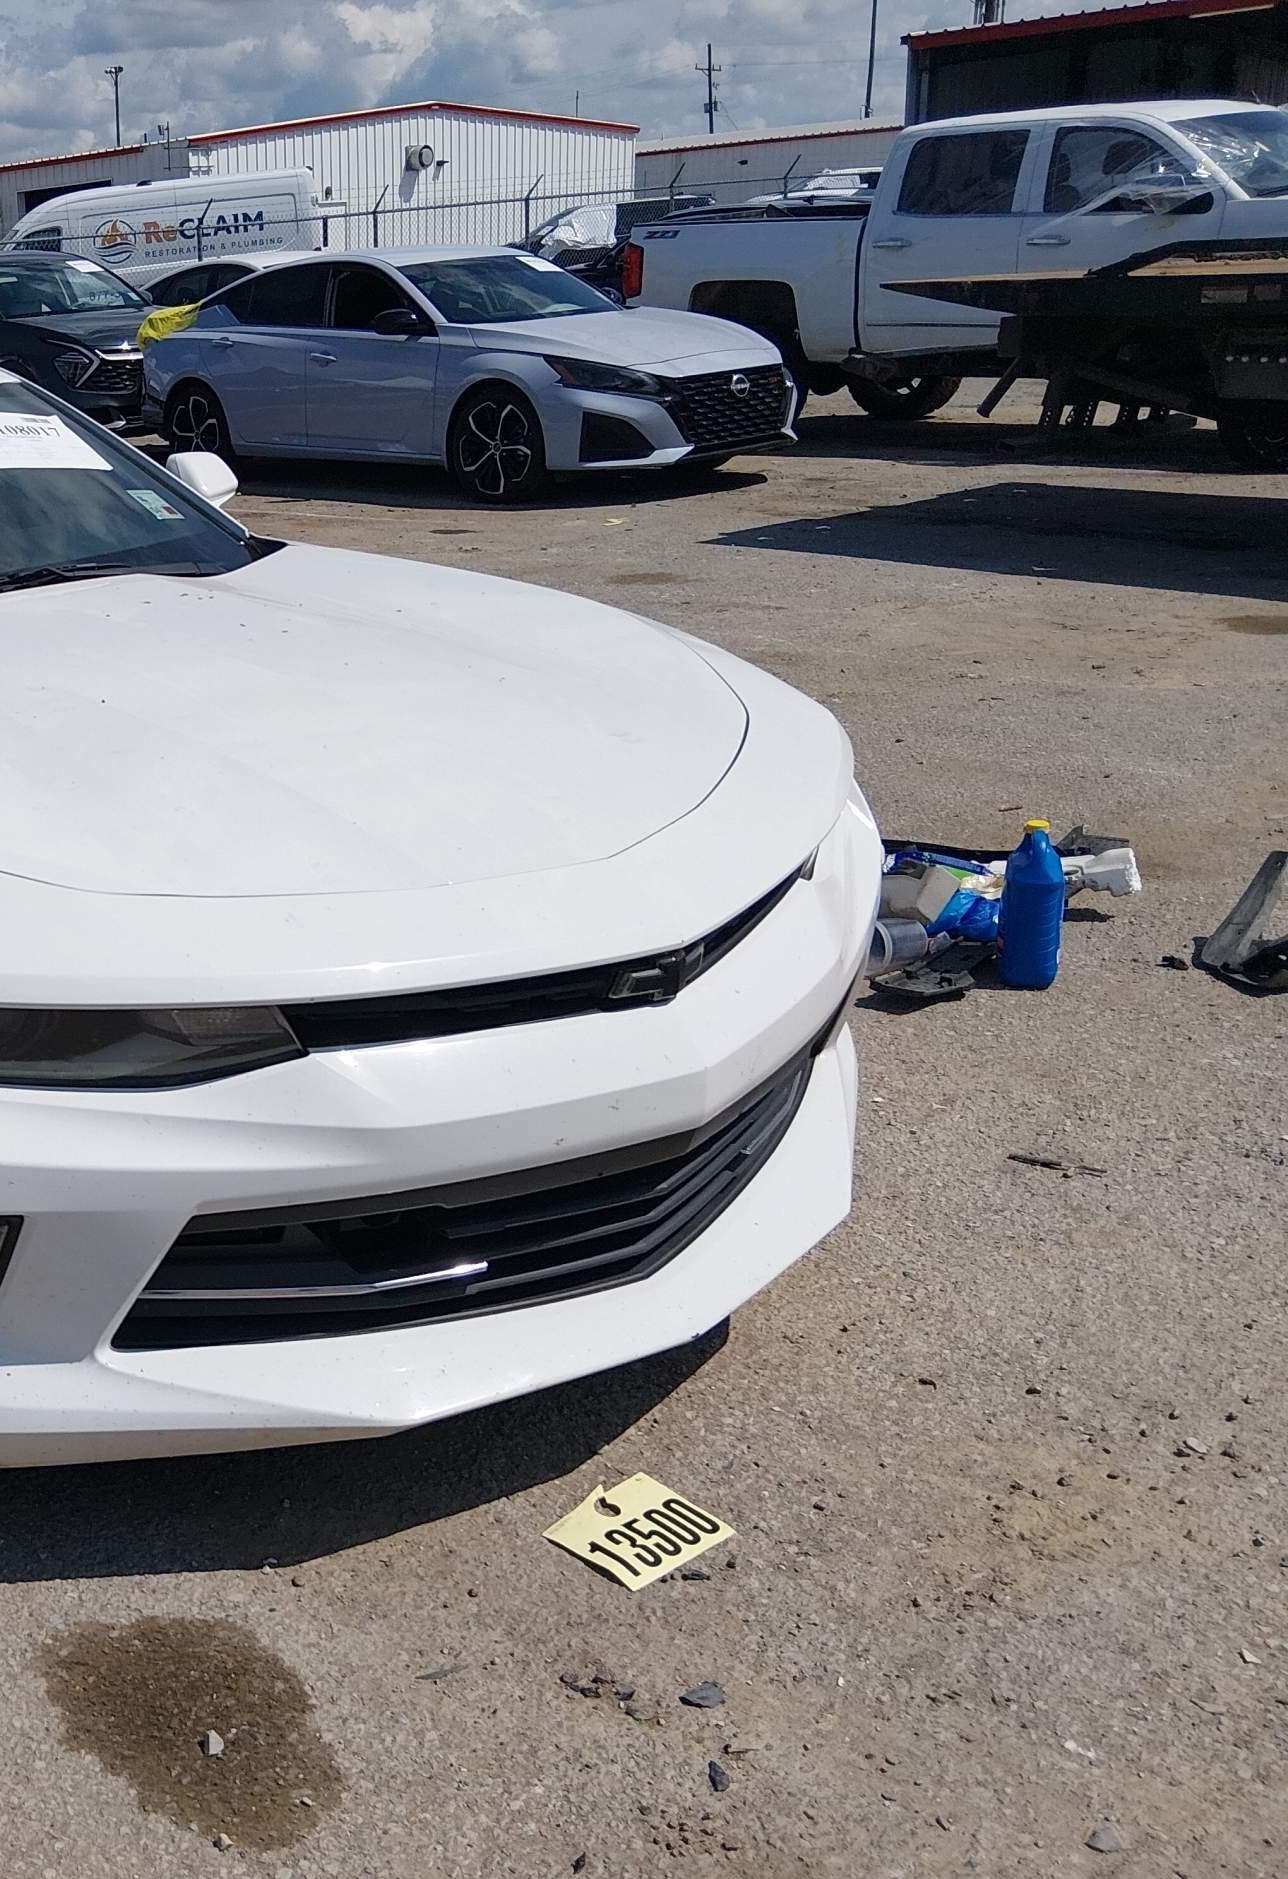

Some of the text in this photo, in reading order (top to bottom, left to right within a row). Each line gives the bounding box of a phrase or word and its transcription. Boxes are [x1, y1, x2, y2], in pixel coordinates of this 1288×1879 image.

[142, 210, 264, 244] ReCLAIM
[144, 245, 216, 258] RESTORATON
[231, 236, 284, 248] PLUMBING
[587, 1498, 721, 1577] 13500
